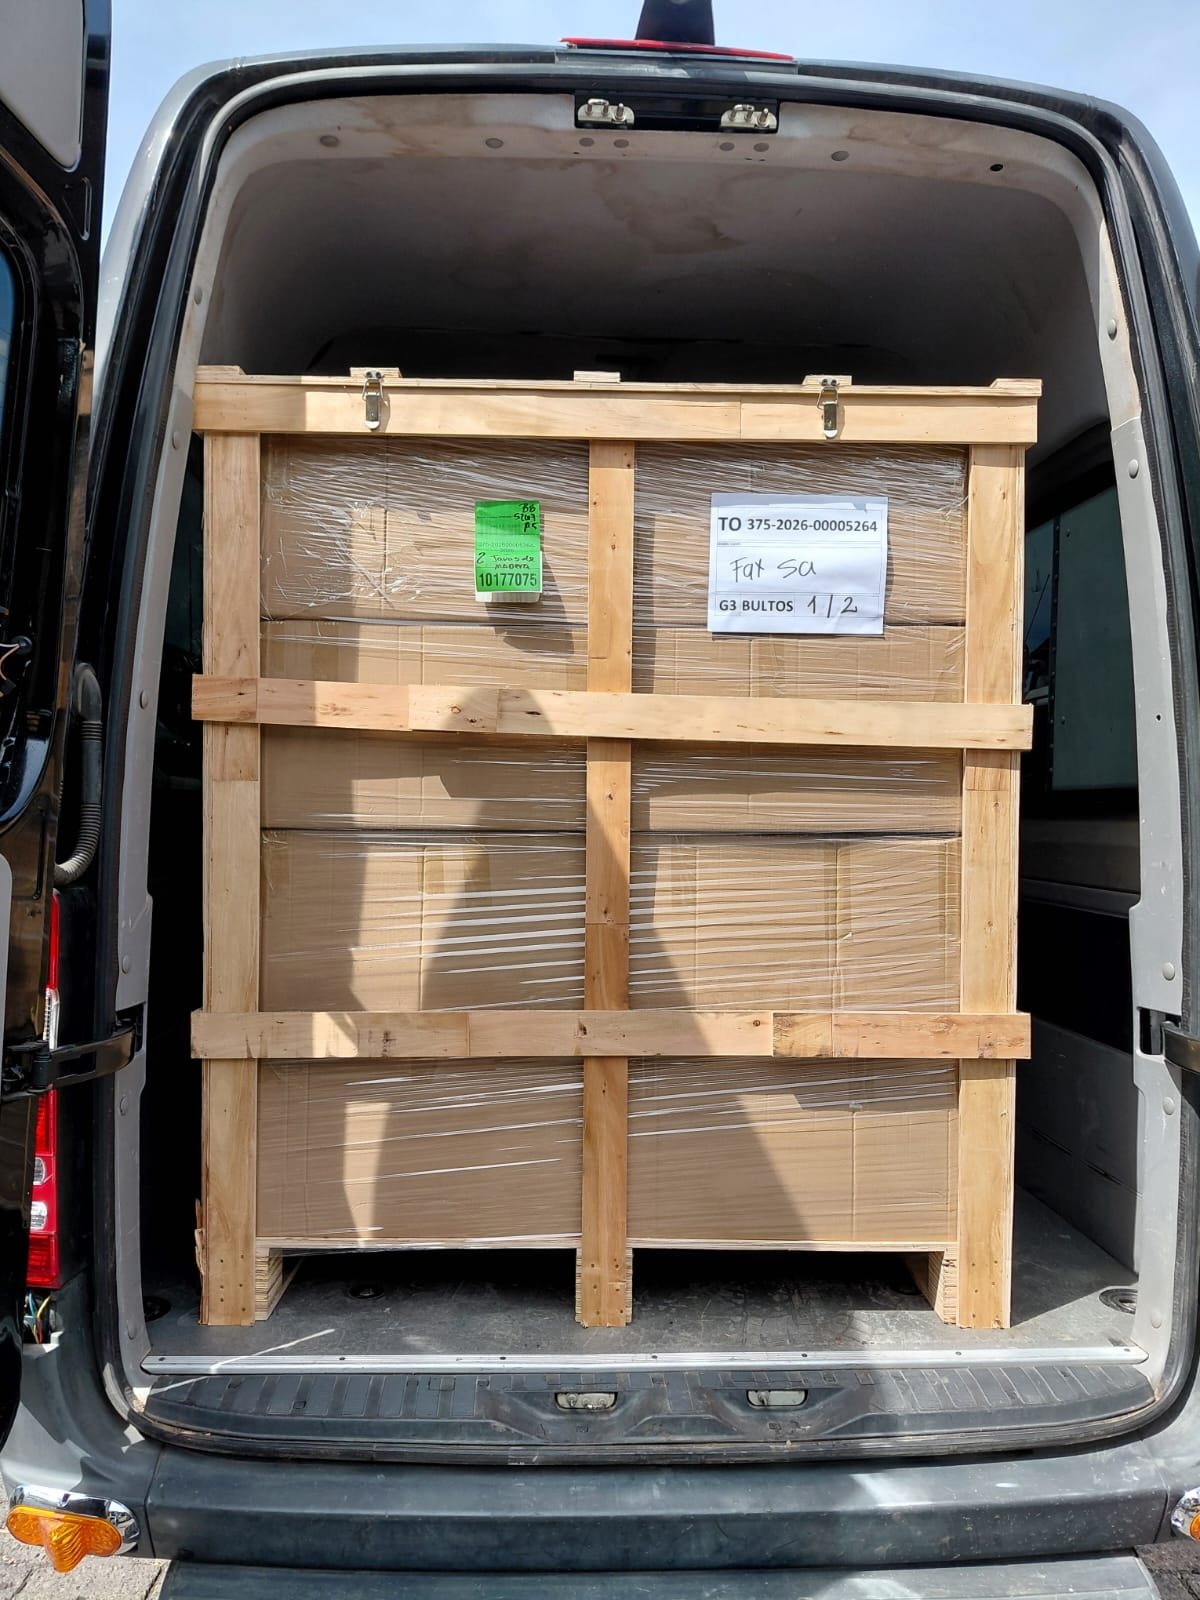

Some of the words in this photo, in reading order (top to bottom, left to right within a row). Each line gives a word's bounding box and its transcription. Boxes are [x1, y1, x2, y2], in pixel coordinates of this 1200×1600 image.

[718, 516, 742, 532] TO
[747, 518, 878, 533] 375-2026-00005264
[479, 572, 537, 587] 10177075
[719, 600, 737, 612] G3
[742, 600, 794, 612] BULTOS
